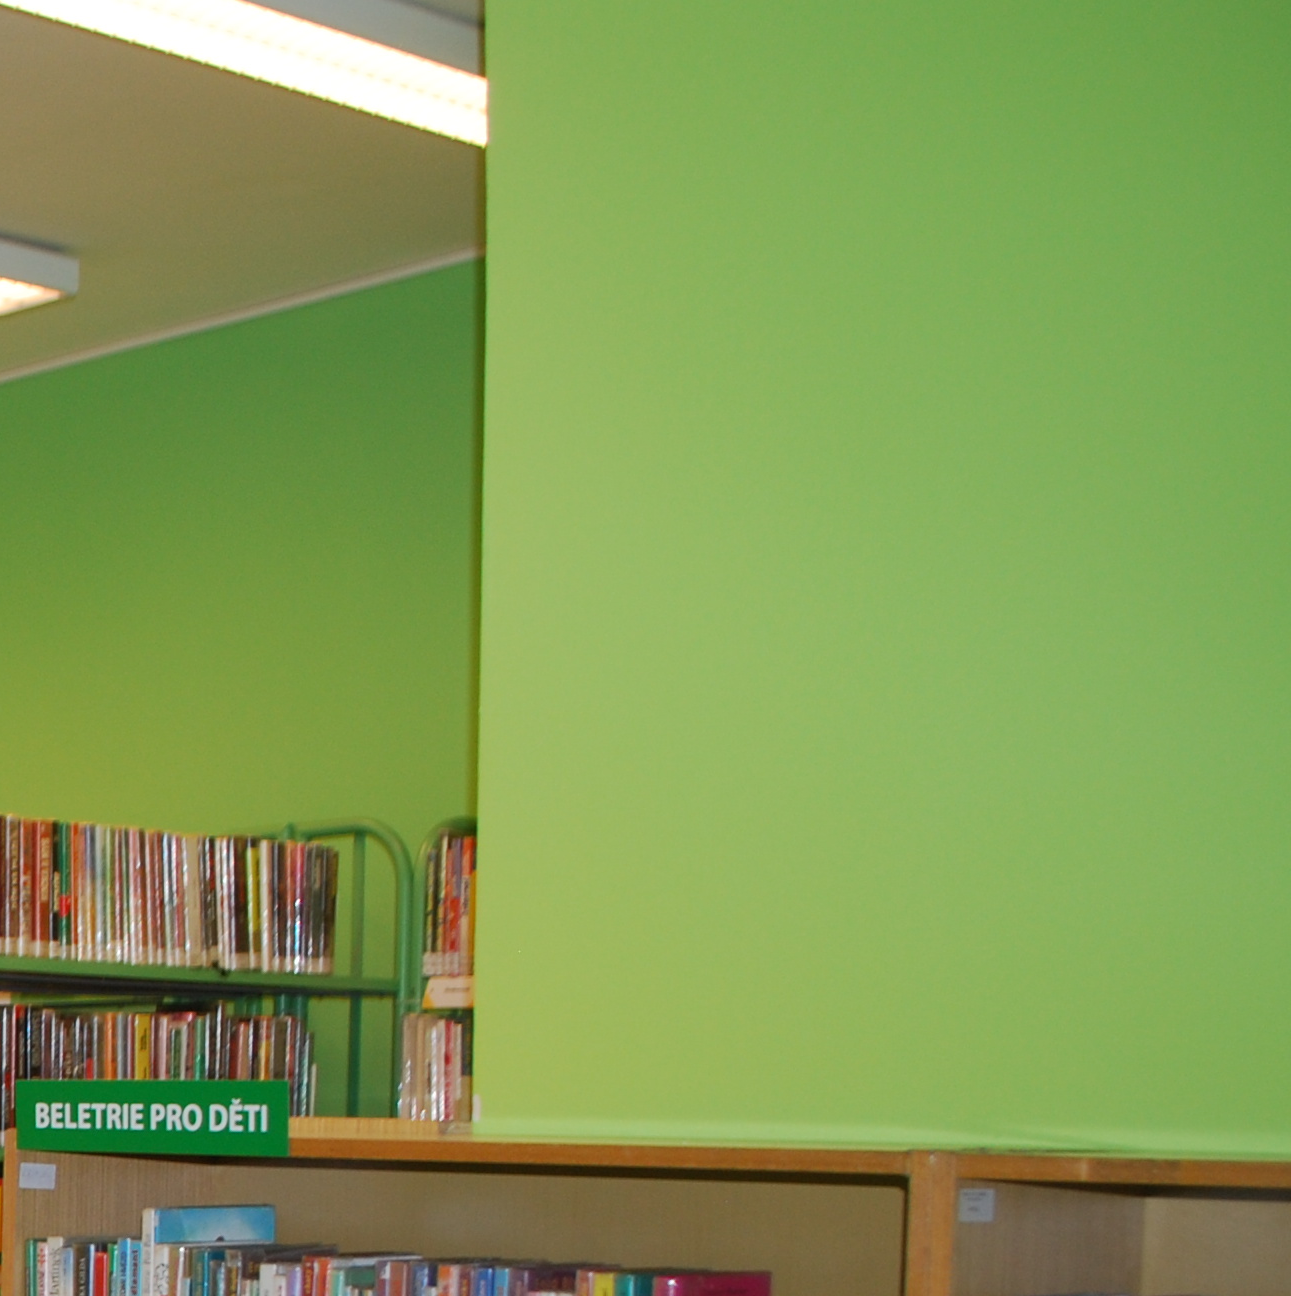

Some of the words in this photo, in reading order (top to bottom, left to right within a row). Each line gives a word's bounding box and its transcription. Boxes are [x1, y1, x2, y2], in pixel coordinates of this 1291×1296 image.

[35, 1101, 144, 1131] BELETRIE
[149, 1102, 202, 1133] PRO
[209, 1096, 268, 1133] DĚTI
